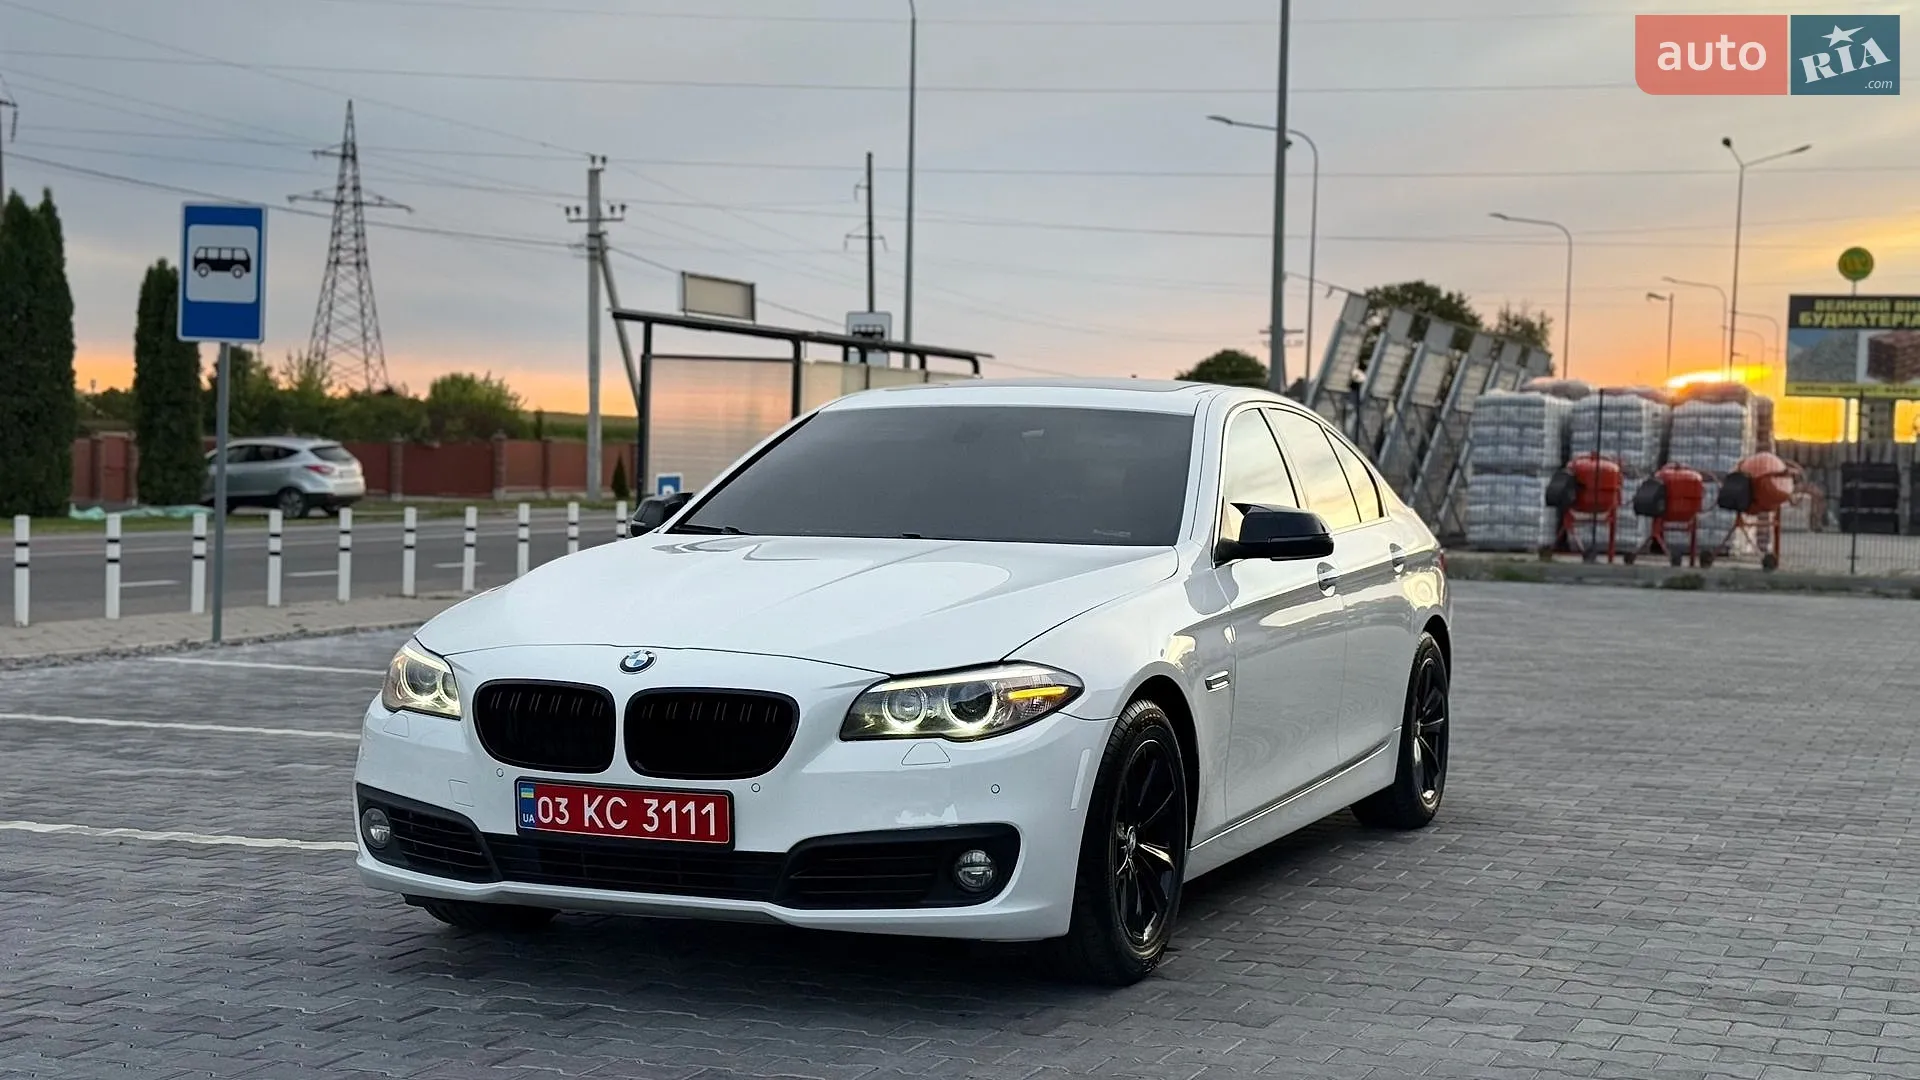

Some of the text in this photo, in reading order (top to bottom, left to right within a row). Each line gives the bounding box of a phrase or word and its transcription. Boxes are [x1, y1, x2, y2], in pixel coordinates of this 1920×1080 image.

[1814, 298, 1891, 312] ВЕЛИКИЙ
[522, 813, 536, 824] UA
[537, 793, 716, 836] 03 KC 3111
